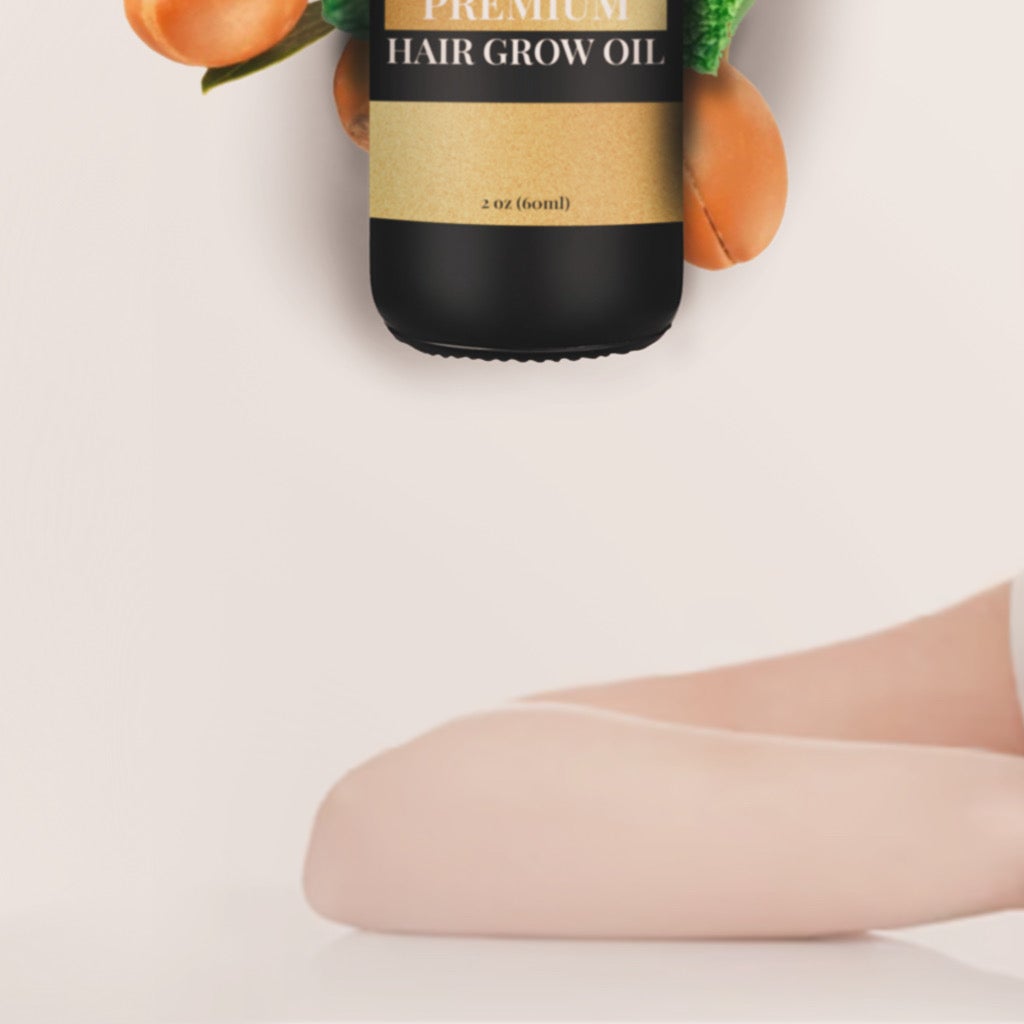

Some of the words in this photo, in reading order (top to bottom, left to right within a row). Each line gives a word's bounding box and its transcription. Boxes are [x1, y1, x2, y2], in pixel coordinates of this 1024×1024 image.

[387, 38, 475, 65] HAIR
[483, 38, 595, 66] GROW
[603, 38, 665, 66] OIL
[481, 199, 490, 210] 2
[493, 199, 512, 210] oz
[516, 195, 571, 212] (60ml)
